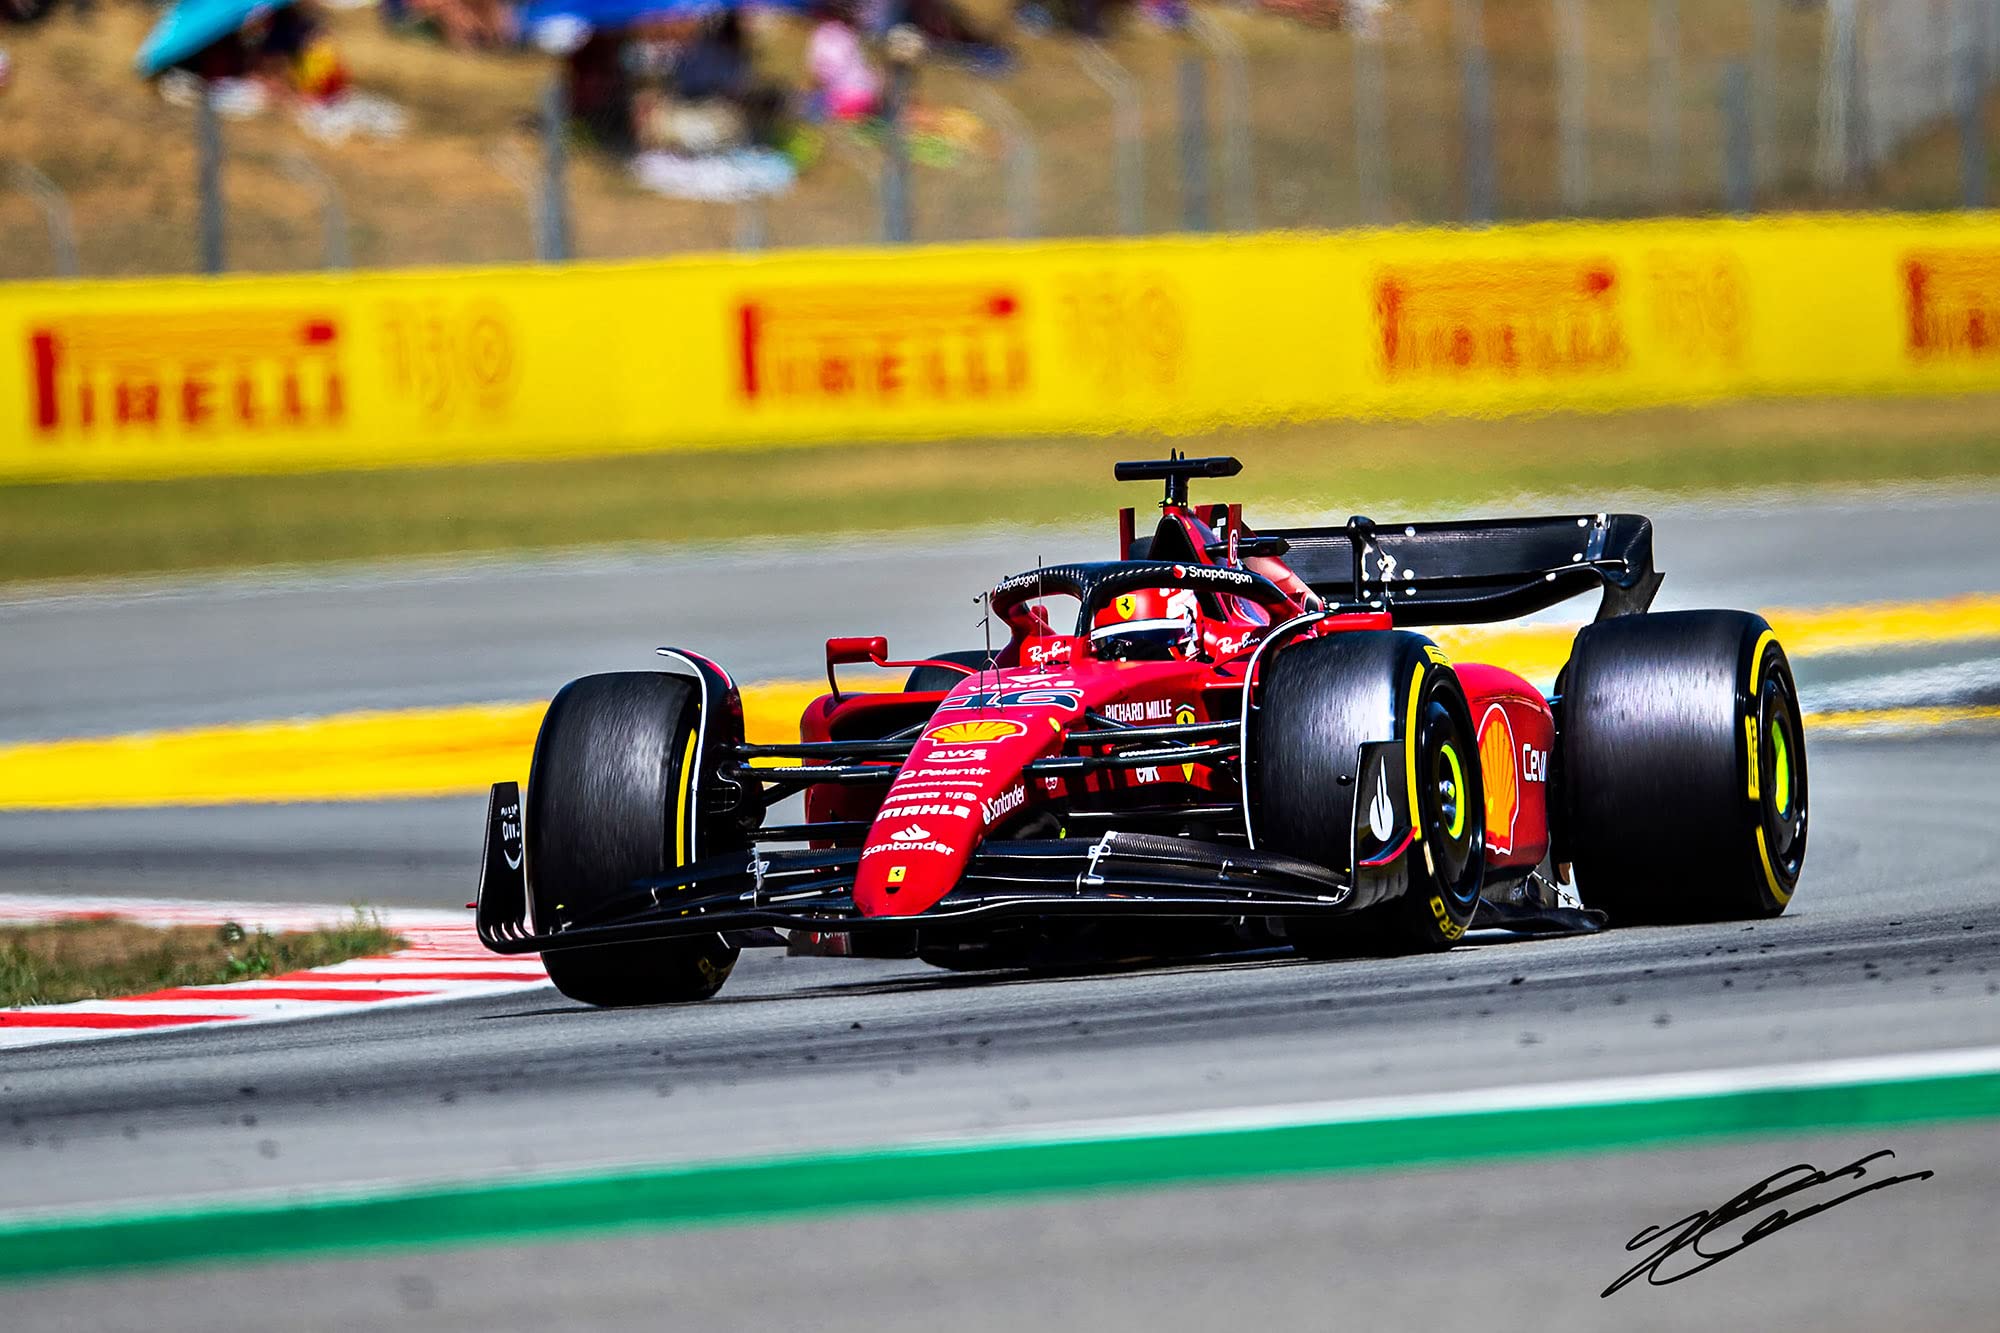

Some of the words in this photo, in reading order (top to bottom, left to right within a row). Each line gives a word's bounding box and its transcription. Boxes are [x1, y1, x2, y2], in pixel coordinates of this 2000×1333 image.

[732, 286, 1028, 403] PIRELLI
[28, 312, 345, 432] PIRELLI
[1189, 565, 1253, 584] Snapdragon
[931, 688, 1085, 717] 16
[1105, 702, 1144, 722] RICHARD
[1146, 699, 1172, 719] MILLE
[918, 767, 991, 777] Palantir
[876, 804, 971, 822] MAHLE
[989, 784, 1025, 821] Santander
[862, 841, 955, 860] Santander
